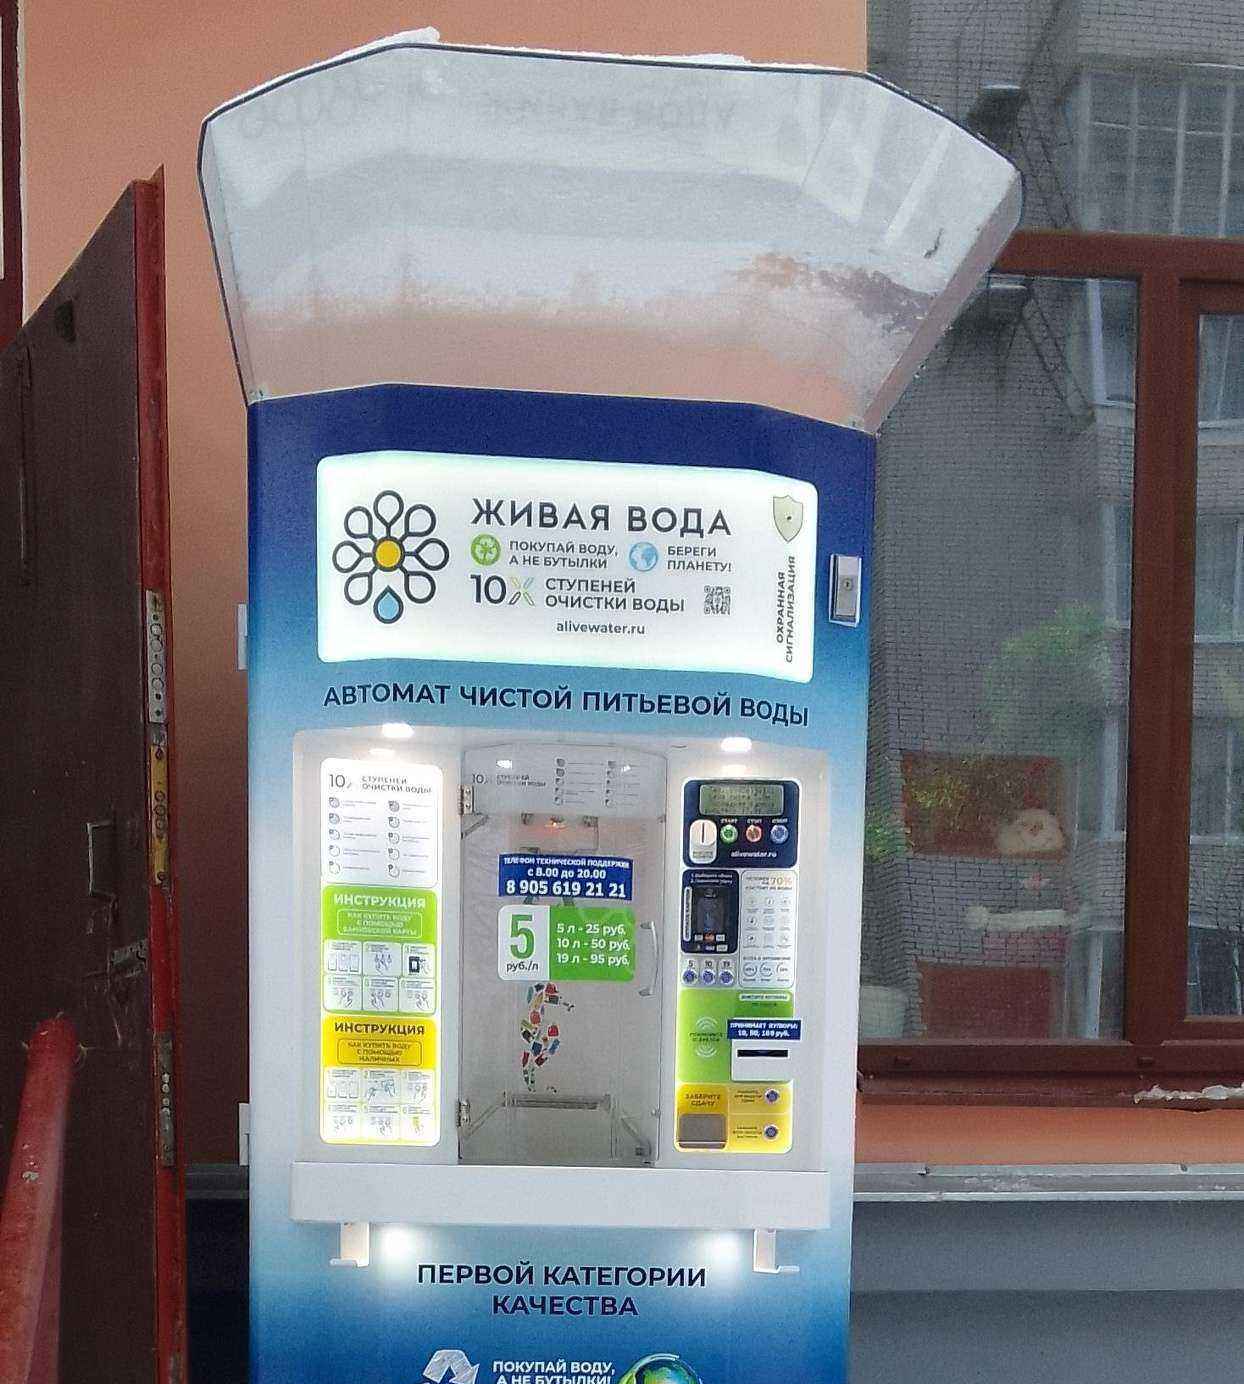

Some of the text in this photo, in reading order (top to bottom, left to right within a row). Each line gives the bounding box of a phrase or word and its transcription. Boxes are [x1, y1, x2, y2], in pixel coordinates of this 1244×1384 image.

[470, 498, 733, 537] ЖИВАЯ ВОДА
[509, 540, 618, 557] ПОКУПАЙ ВОДУ,
[667, 545, 717, 557] БЕРЕГИ
[509, 555, 608, 569] А НЕ БУТЫЛКИ
[667, 560, 732, 573] ПЛАНЕТУ!
[545, 577, 636, 594] СТУПЕНЕЙ
[545, 595, 685, 613] ОЧИСТКИ ВОДЫ
[776, 571, 786, 644] ОХРАННАЯ
[785, 556, 796, 663] СИГНАЛИЗАЦИЯ
[556, 620, 645, 635] alivewater.ru
[323, 683, 809, 727] АВТОМАТ ЧИСТОЙ ПИТЬЕВОЙ ВОДЫ
[535, 868, 558, 877] 8.00
[561, 871, 574, 879] до
[577, 869, 606, 879] 20.00
[506, 880, 626, 898] 8 905 619 21 21
[334, 893, 426, 909] ИНСТРУКЦИЯ
[510, 914, 535, 960] 5
[557, 924, 564, 933] 5
[566, 924, 575, 933] л
[585, 925, 600, 934] 25
[603, 924, 626, 936] руб.
[557, 939, 569, 948] 10
[571, 940, 580, 949] л
[591, 940, 606, 949] 50
[609, 940, 630, 952] руб.
[506, 960, 539, 972] руб./л
[557, 954, 569, 963] 19
[571, 955, 580, 964] л
[590, 955, 605, 964] 95
[607, 955, 629, 966] руб.
[335, 1022, 425, 1036] ИНСТРУКЦИЯ
[417, 1261, 707, 1287] ПЕРВОЙ КАТЕГОРИИ
[492, 1294, 639, 1317] КАЧЕСТВА
[493, 1358, 616, 1375] ПОКУПАЙ ВОДУ,
